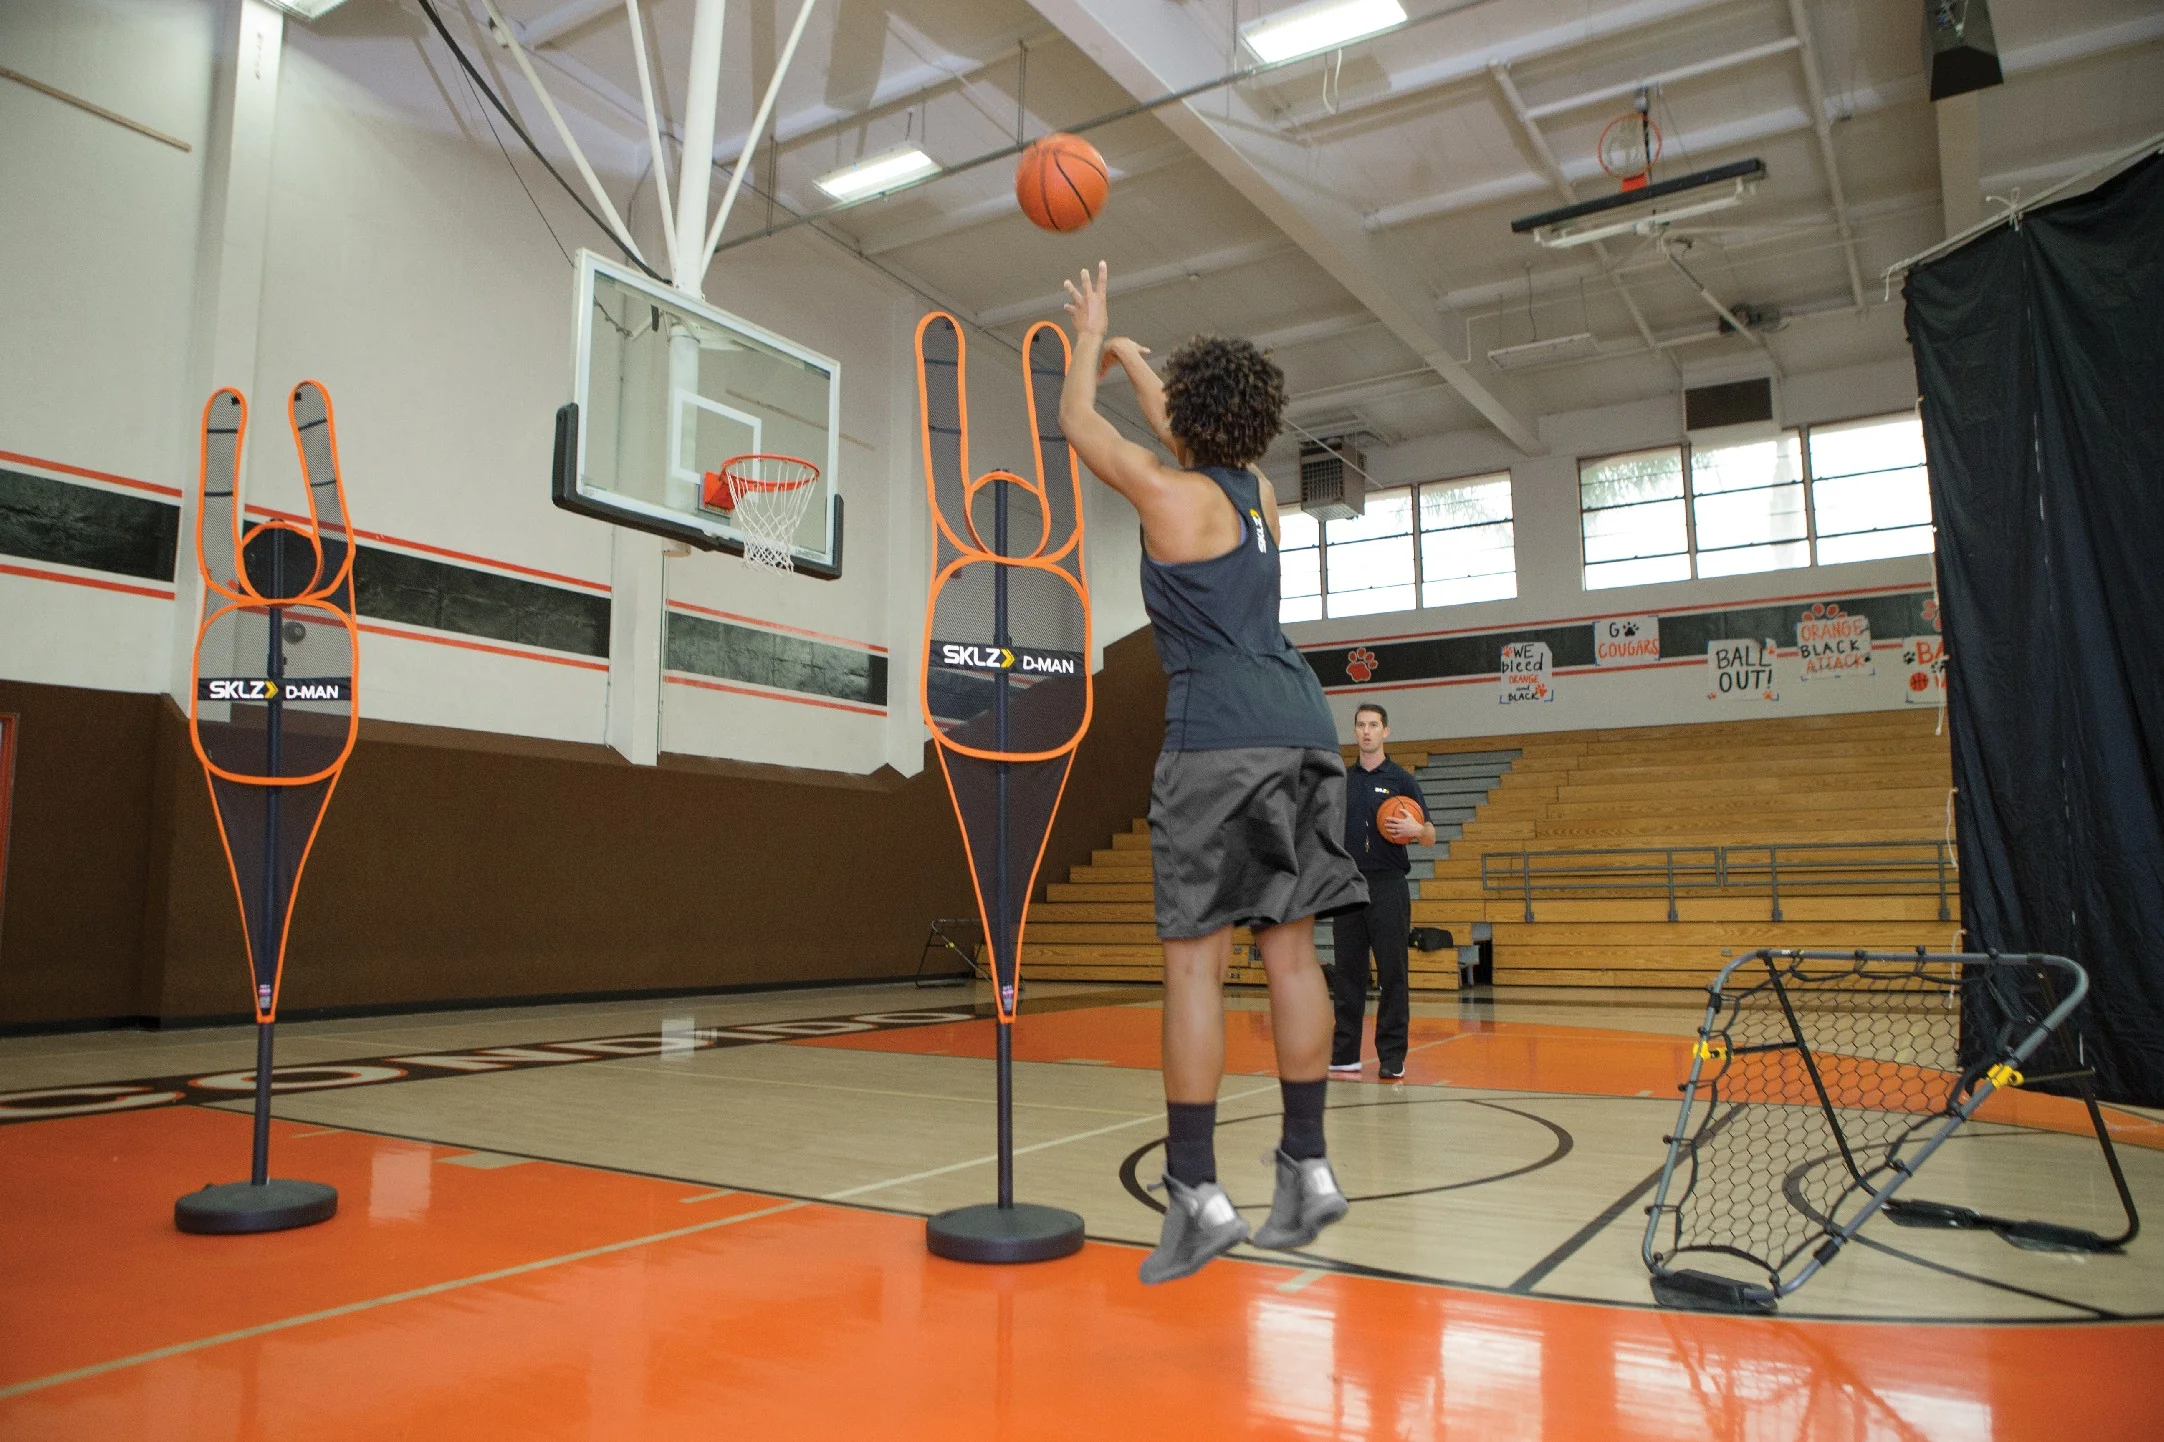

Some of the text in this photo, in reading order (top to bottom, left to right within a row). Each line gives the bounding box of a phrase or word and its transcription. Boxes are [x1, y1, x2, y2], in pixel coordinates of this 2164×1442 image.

[1801, 619, 1864, 642] ORANGE
[942, 644, 1074, 674] SKLZ D-MAN
[1513, 644, 1535, 659] WE
[1598, 638, 1659, 659] COUGARS
[1716, 645, 1772, 670] BALL
[1800, 640, 1860, 659] BLACK
[1501, 652, 1544, 674] bleed
[1806, 654, 1864, 674] ATTACK
[209, 680, 339, 699] SKLZ D-MAN
[1719, 669, 1773, 693] OUT!
[1508, 692, 1540, 702] BLACK
